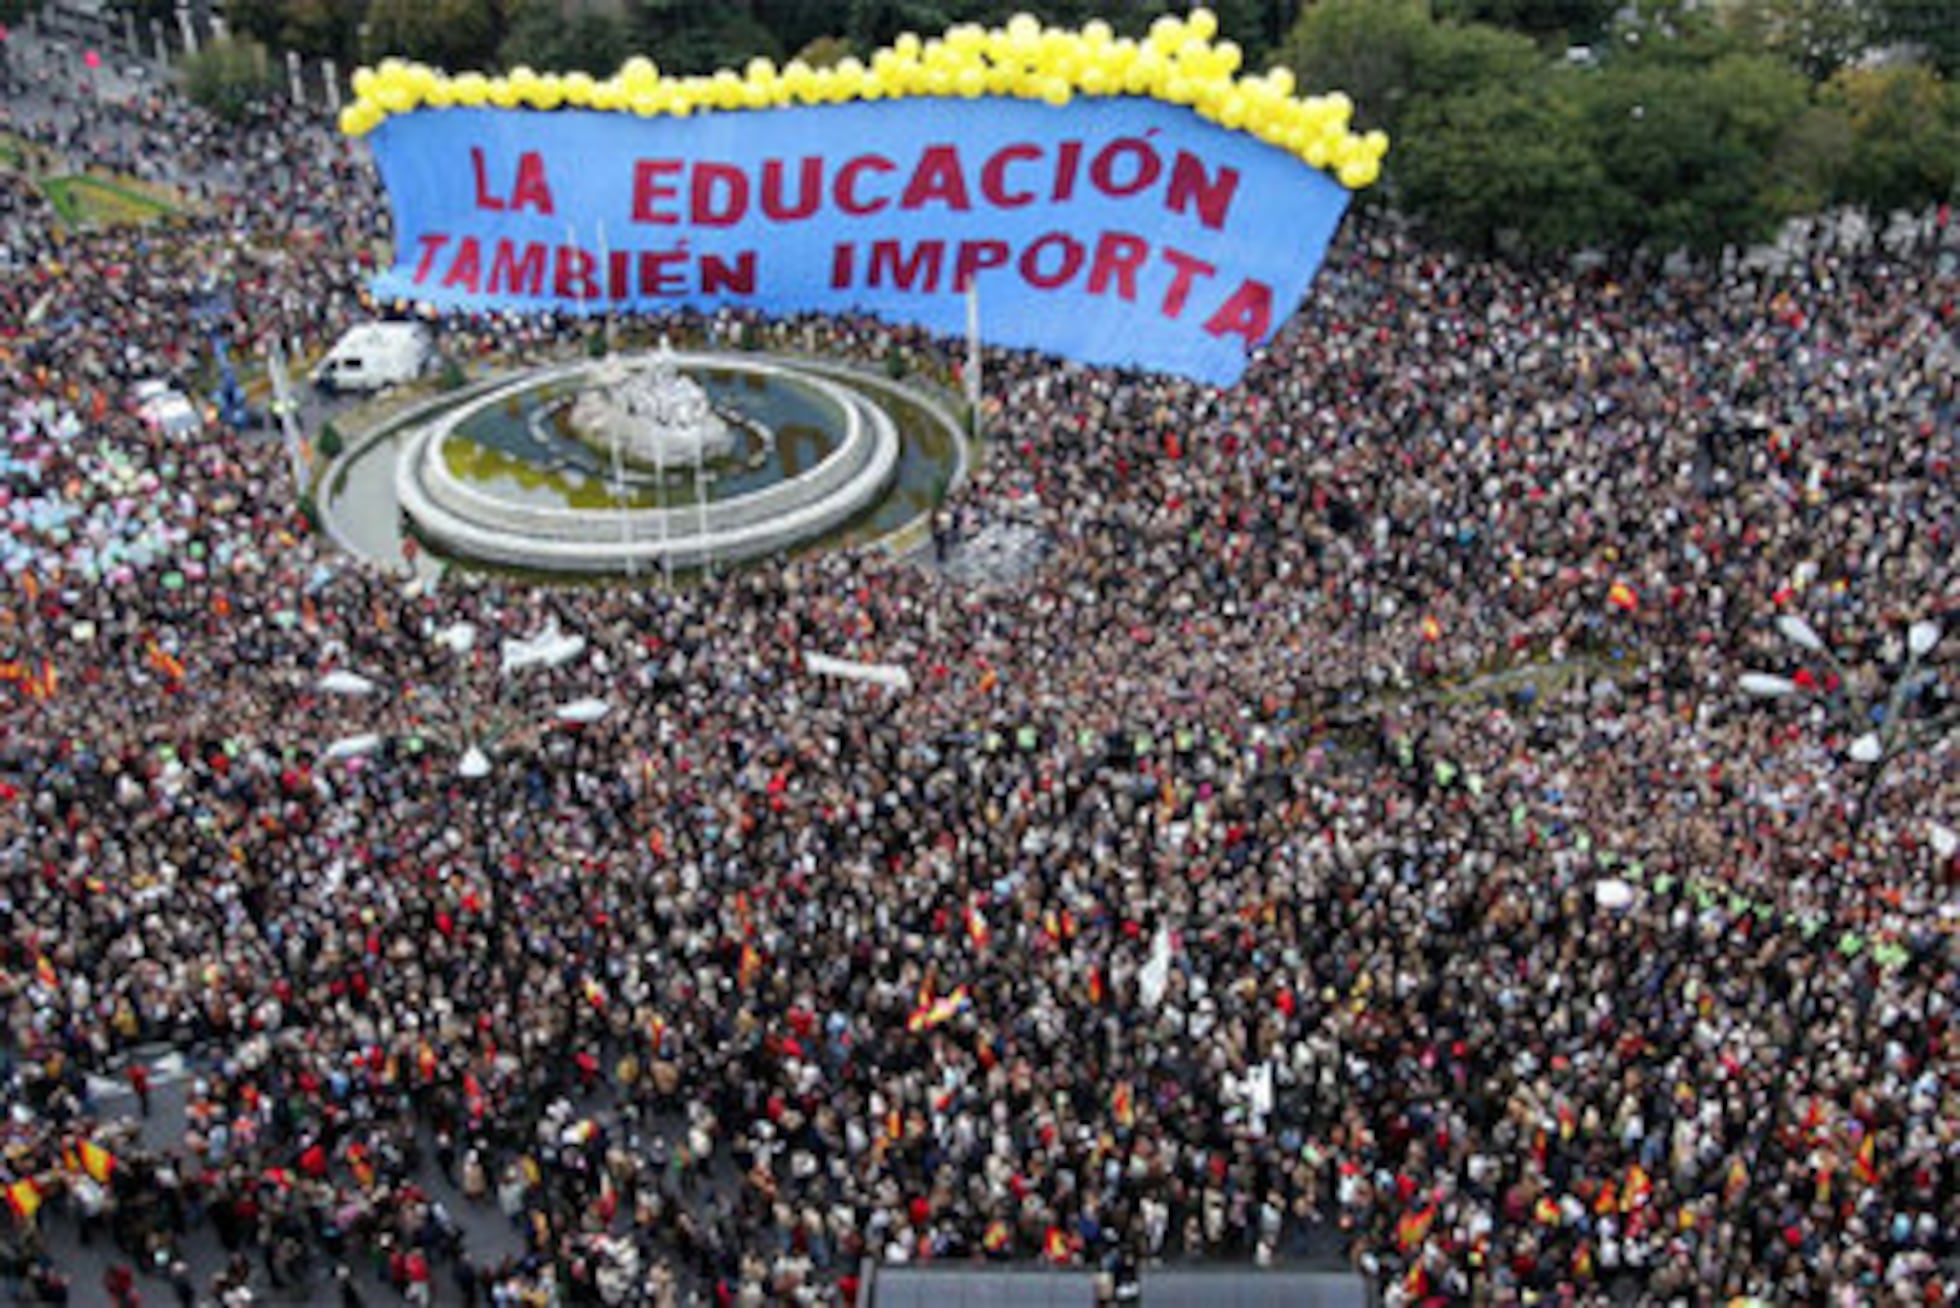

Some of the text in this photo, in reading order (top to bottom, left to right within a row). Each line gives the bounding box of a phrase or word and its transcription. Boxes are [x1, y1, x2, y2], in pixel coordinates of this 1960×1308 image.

[470, 128, 1241, 231] LA EDUCACIÓN
[412, 229, 1277, 347] TAMBIÉN IMPORTA
